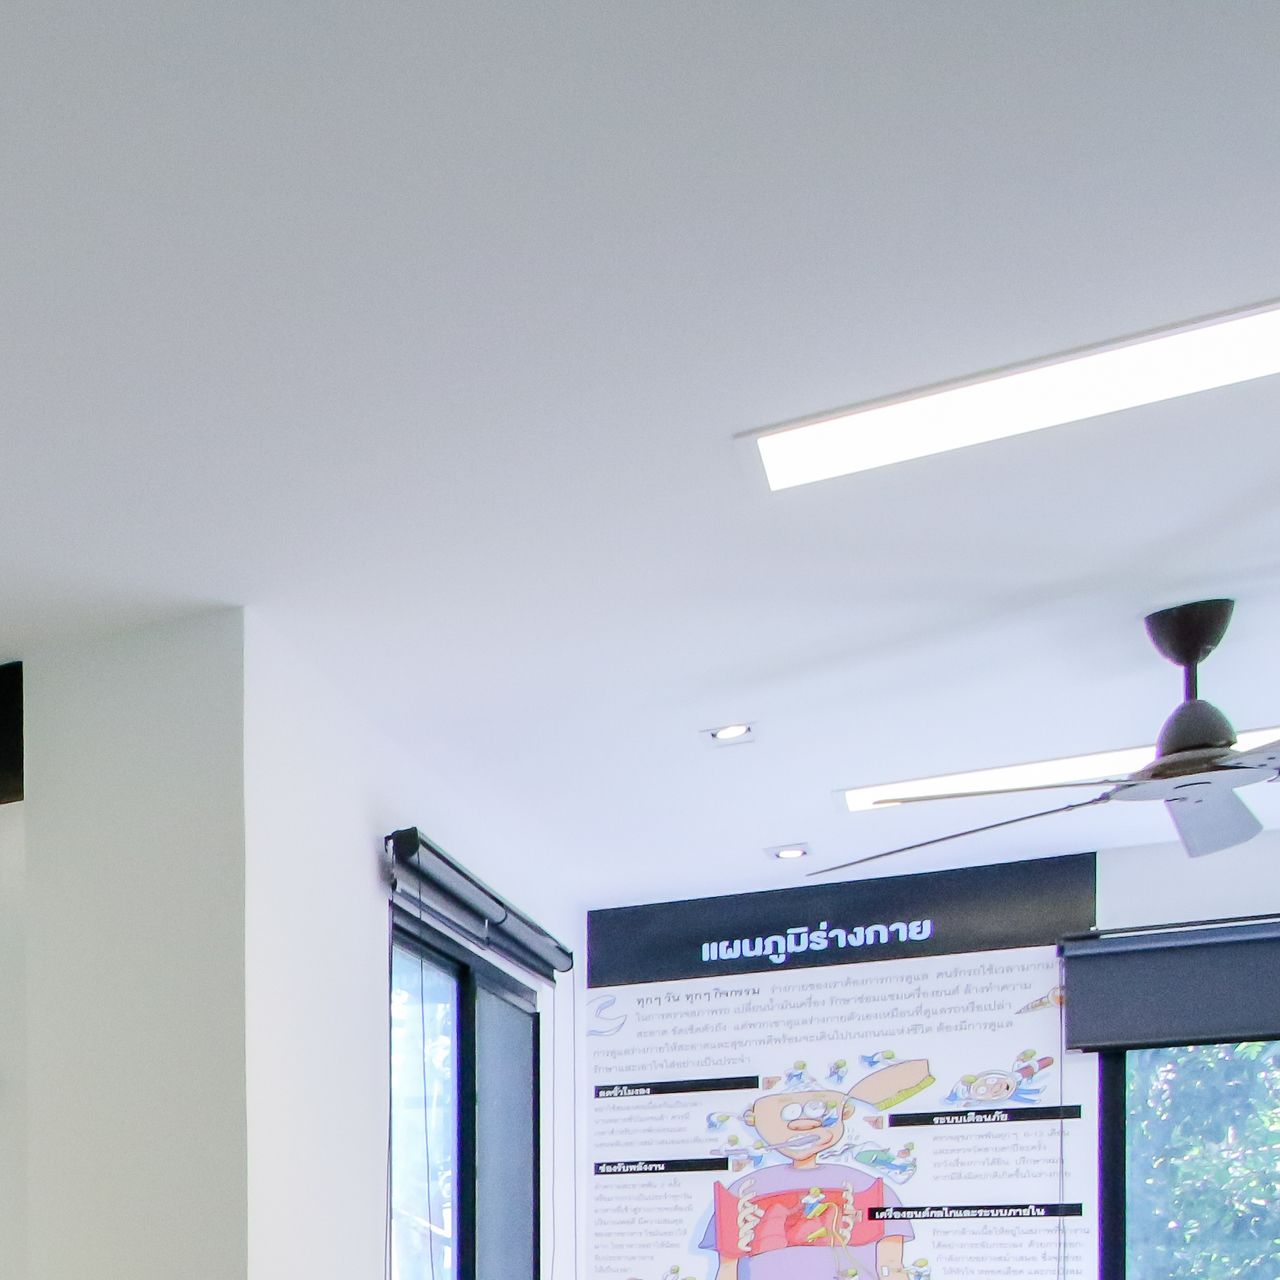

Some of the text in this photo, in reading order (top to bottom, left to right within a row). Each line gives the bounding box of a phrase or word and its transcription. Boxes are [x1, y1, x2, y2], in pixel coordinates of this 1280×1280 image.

[702, 918, 932, 964] แผนภูมิร่างกาย
[933, 1112, 1009, 1124] ระบบเตือนภัย
